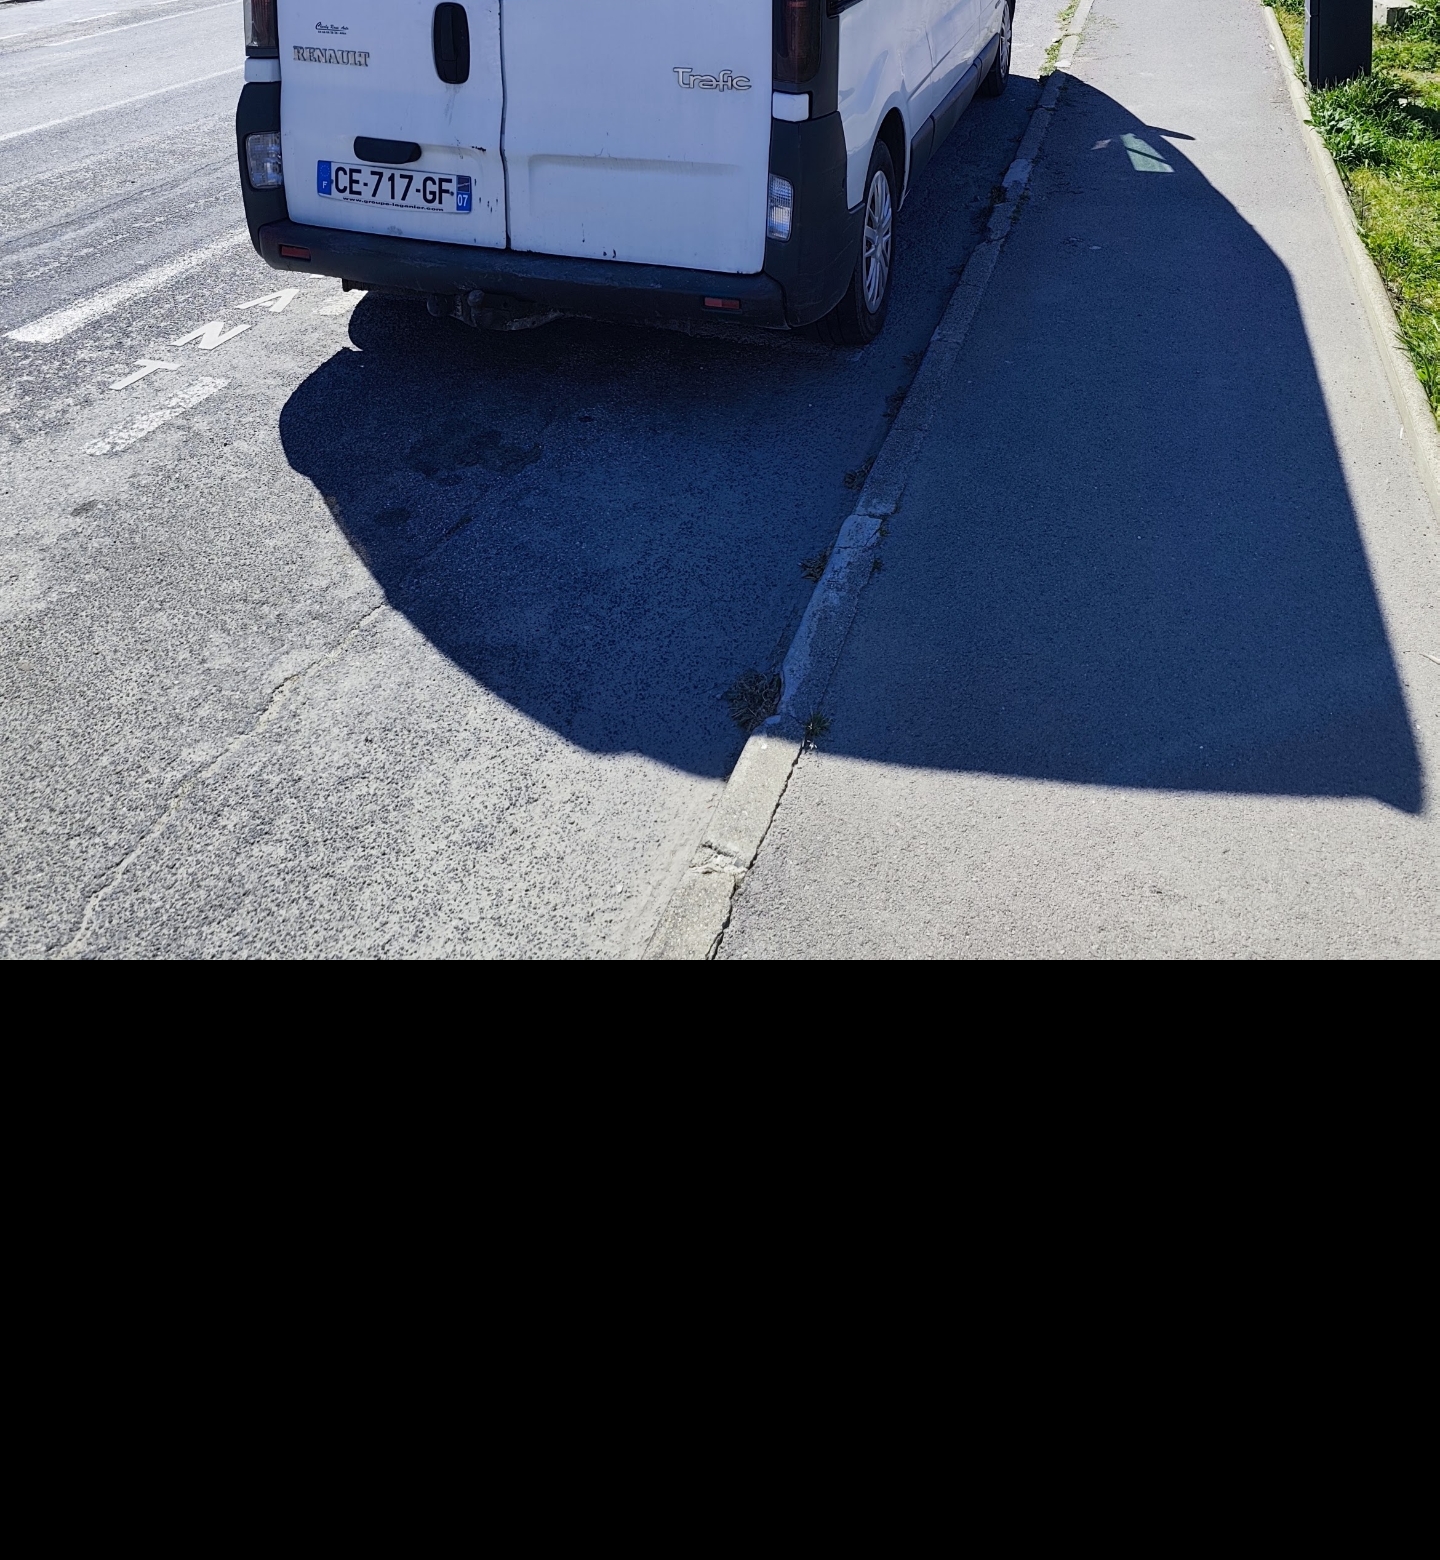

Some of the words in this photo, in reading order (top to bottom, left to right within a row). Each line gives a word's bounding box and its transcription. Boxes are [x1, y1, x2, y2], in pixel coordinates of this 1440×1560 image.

[293, 45, 370, 67] RENAULT
[672, 66, 752, 93] Trafic
[322, 181, 328, 189] F
[334, 166, 453, 205] CE-717-GF
[457, 194, 469, 207] 07
